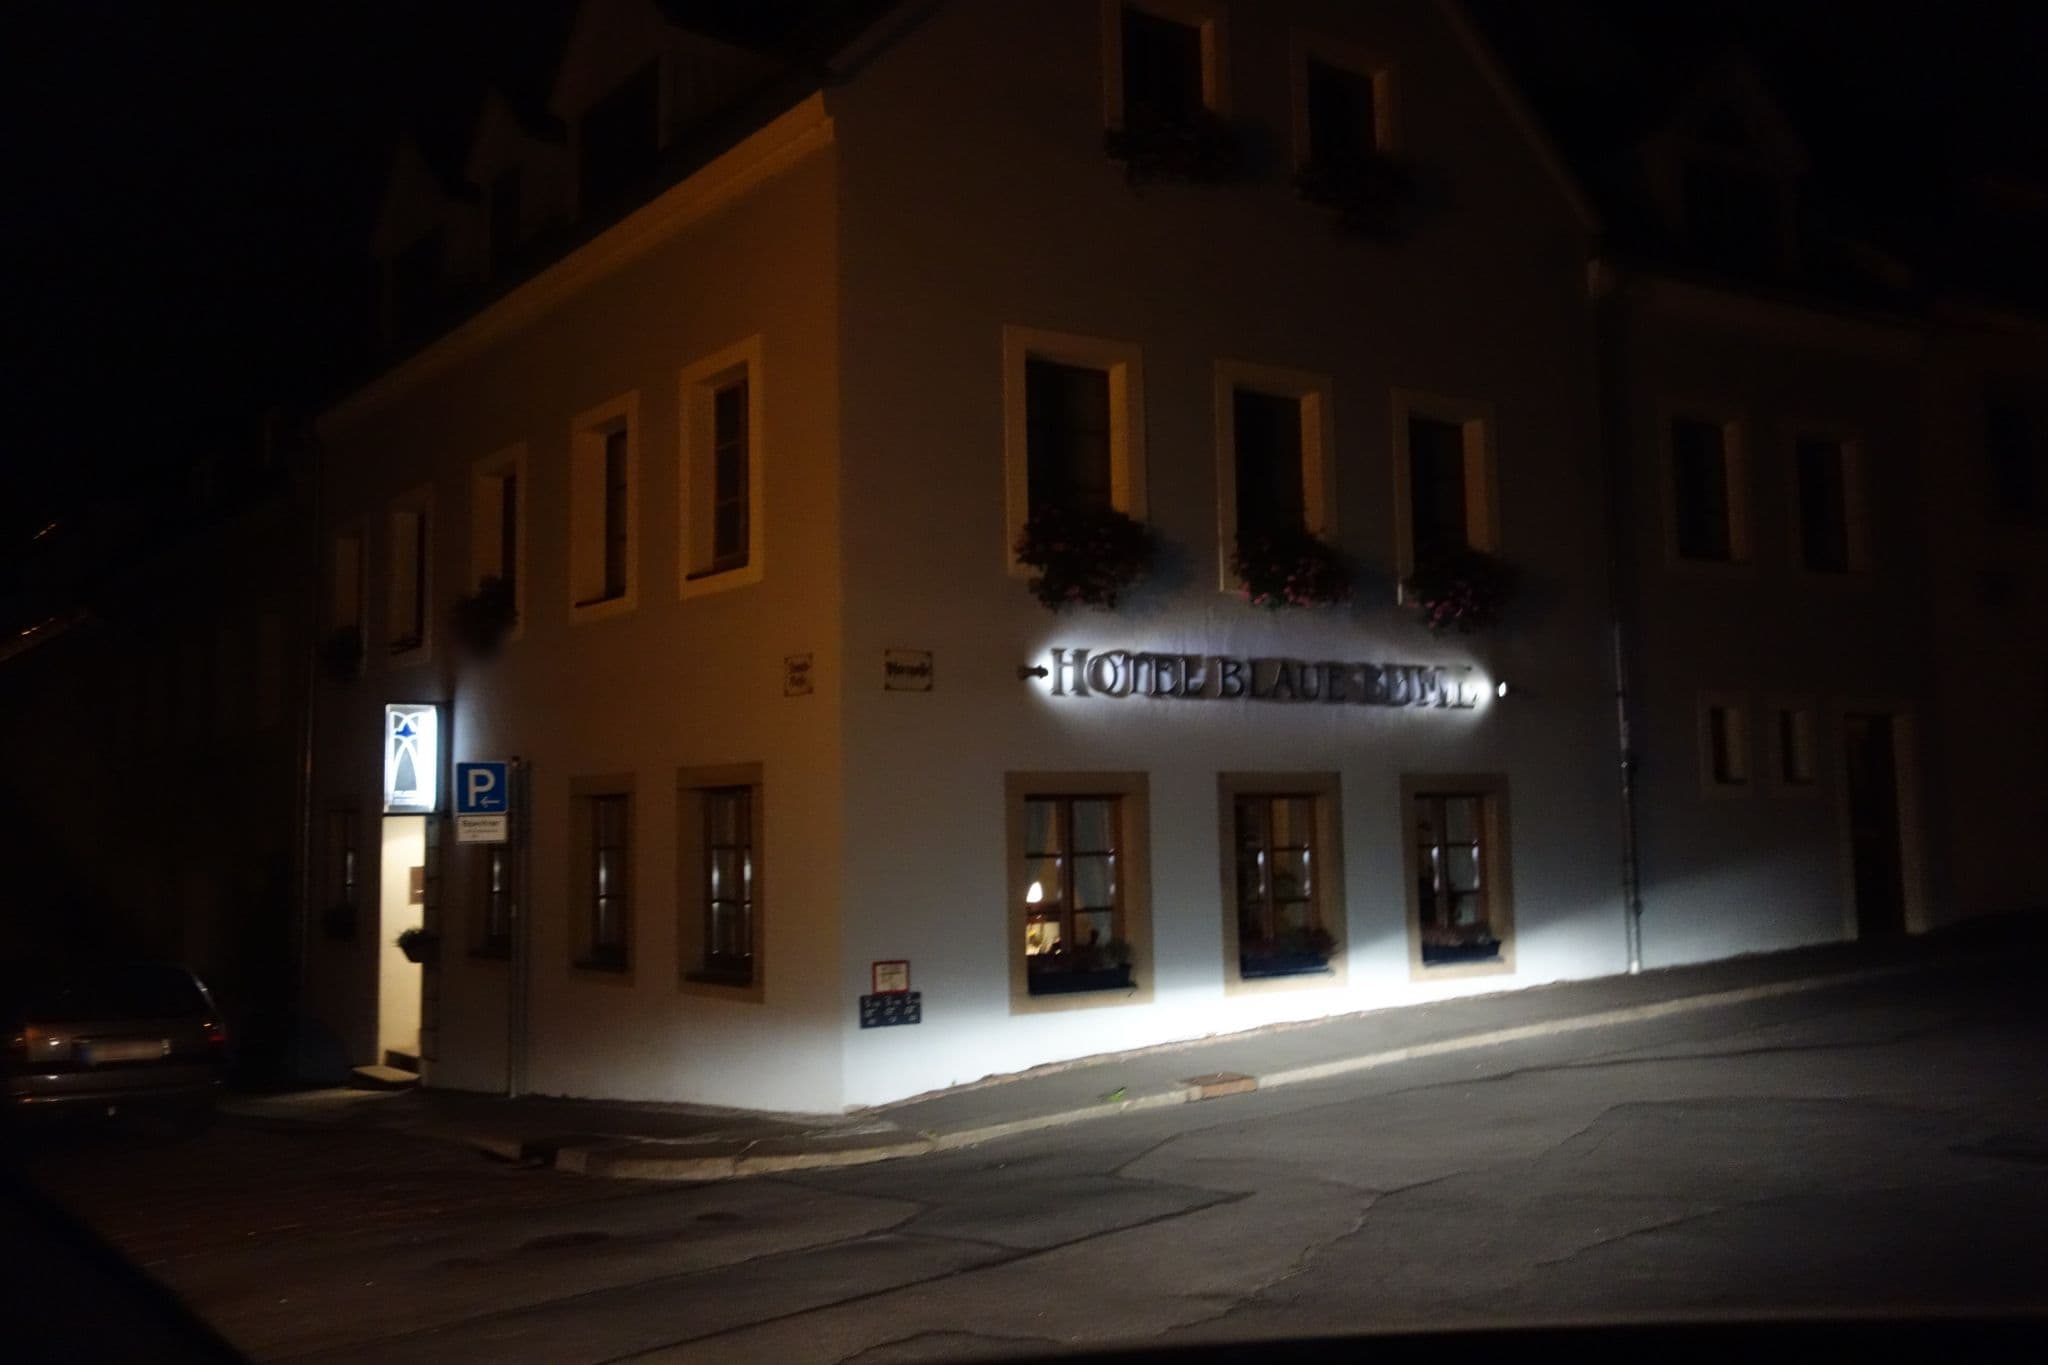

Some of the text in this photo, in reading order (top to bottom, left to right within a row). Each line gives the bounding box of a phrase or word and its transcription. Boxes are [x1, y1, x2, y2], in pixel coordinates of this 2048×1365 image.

[1050, 648, 1204, 699] HOTEL
[1214, 656, 1347, 703] BLAUE
[468, 768, 496, 808] P
